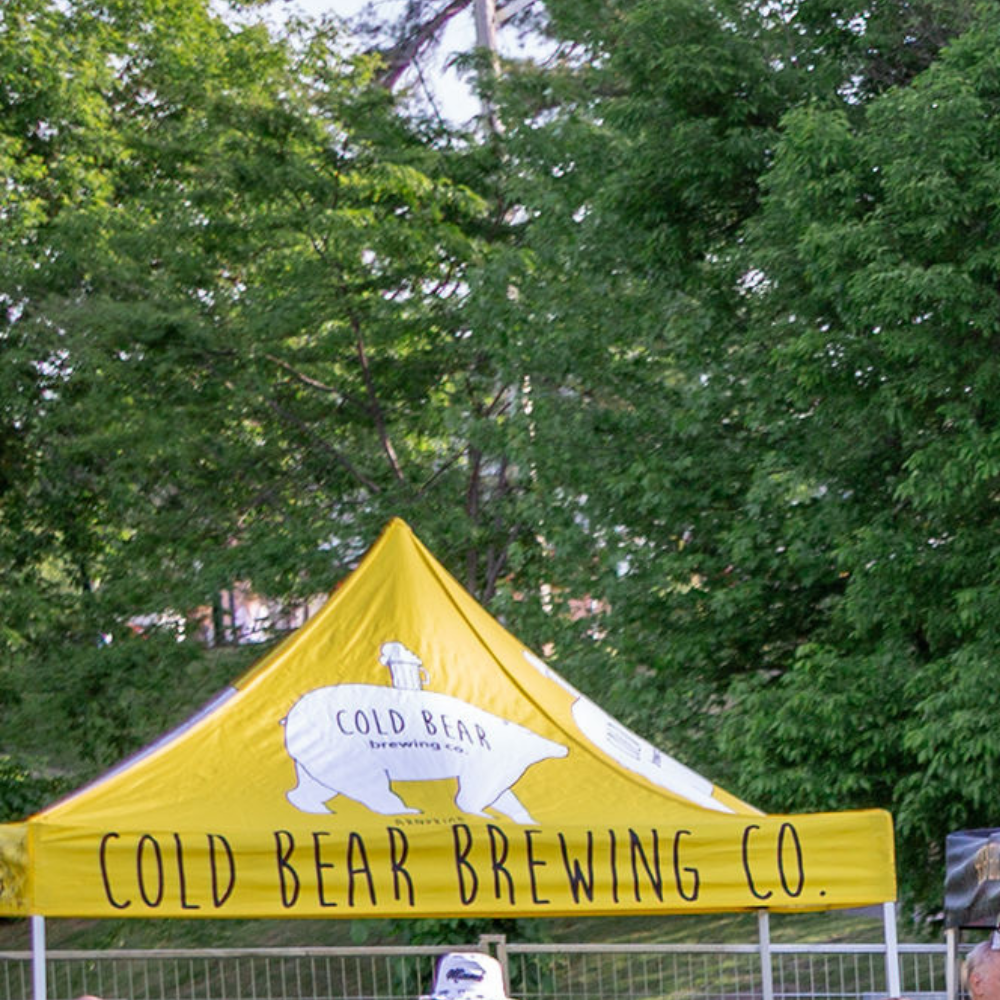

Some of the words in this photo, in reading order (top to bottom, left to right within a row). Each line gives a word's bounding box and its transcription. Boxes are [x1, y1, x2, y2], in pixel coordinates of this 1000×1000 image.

[336, 708, 406, 736] COLD
[421, 708, 492, 752] BEAR
[369, 739, 442, 752] brewing
[444, 743, 470, 755] co.
[98, 831, 237, 910] COLD
[273, 829, 416, 908] BEAR
[451, 823, 701, 906] BREWING
[741, 822, 828, 900] CO.
